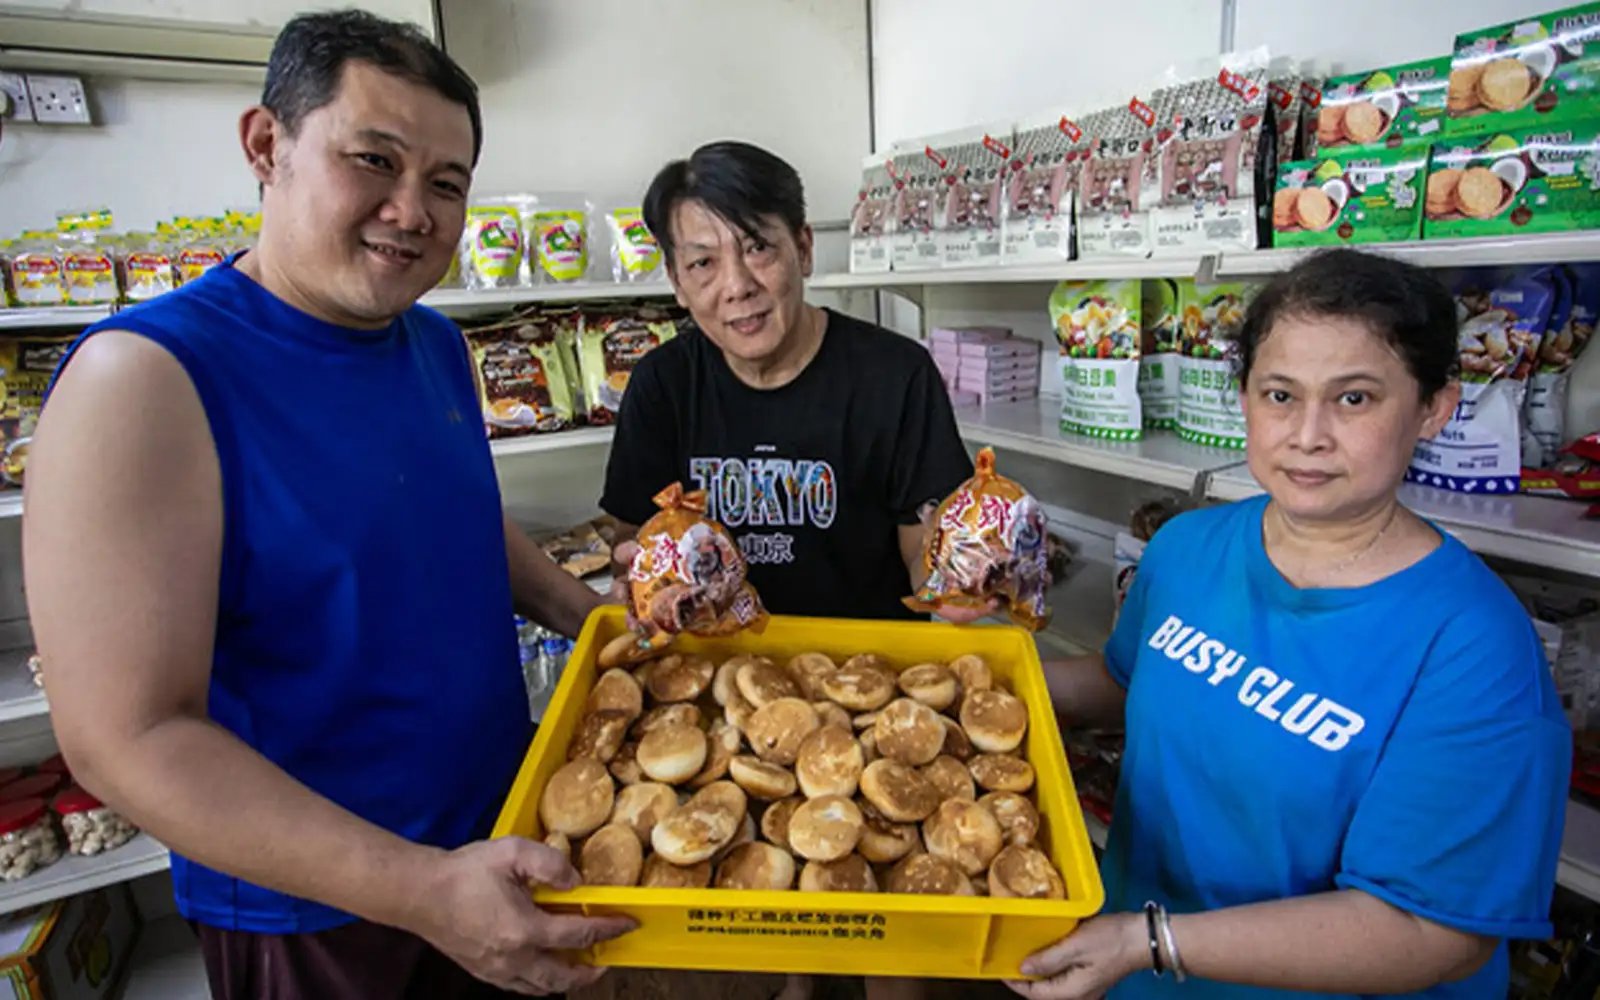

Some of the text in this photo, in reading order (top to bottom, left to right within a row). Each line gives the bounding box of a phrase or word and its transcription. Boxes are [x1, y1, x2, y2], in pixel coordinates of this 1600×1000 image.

[690, 457, 837, 529] TOKYO
[1148, 614, 1365, 752] BUSY CLUB
